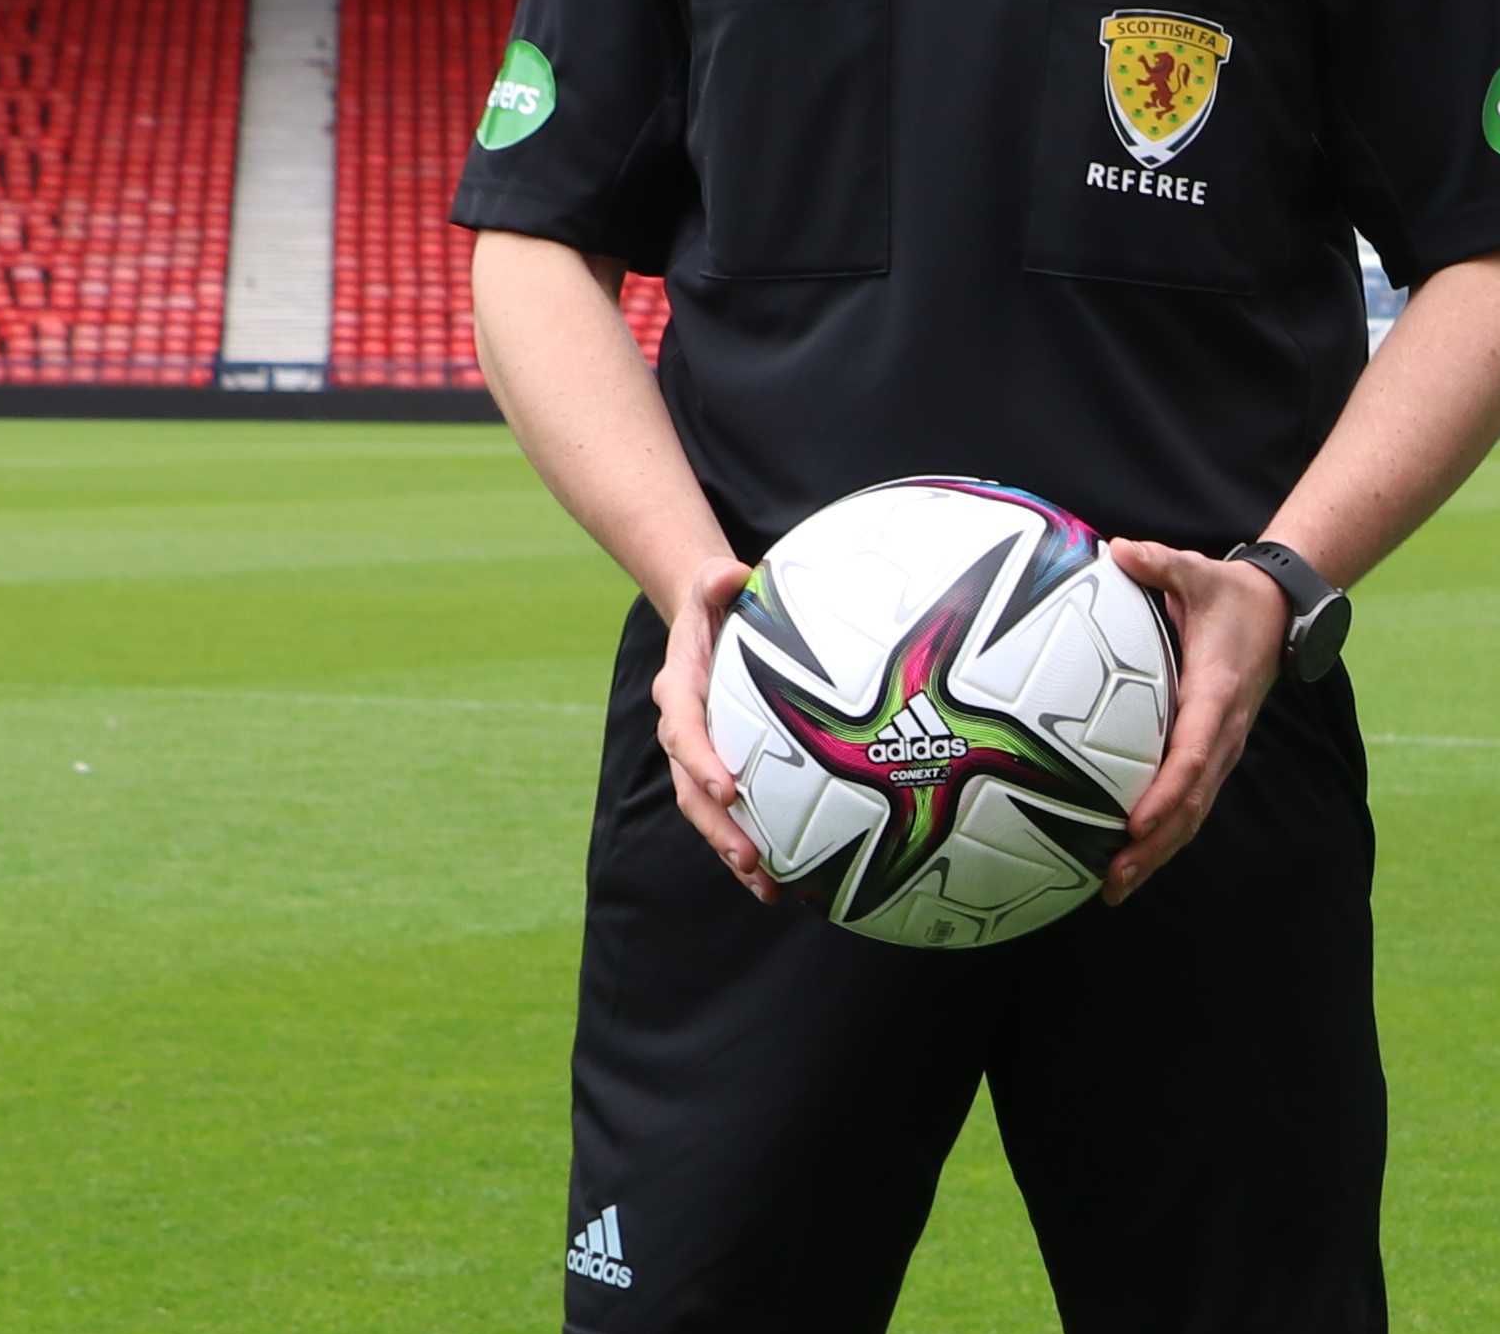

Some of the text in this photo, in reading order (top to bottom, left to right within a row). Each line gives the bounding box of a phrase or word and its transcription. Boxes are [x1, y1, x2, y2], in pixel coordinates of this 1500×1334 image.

[1117, 20, 1217, 49] SCOTTISH FA
[1086, 162, 1208, 205] REFEREE
[867, 735, 967, 763] adidas
[889, 768, 940, 781] CONEXT
[567, 1248, 633, 1289] adidas
